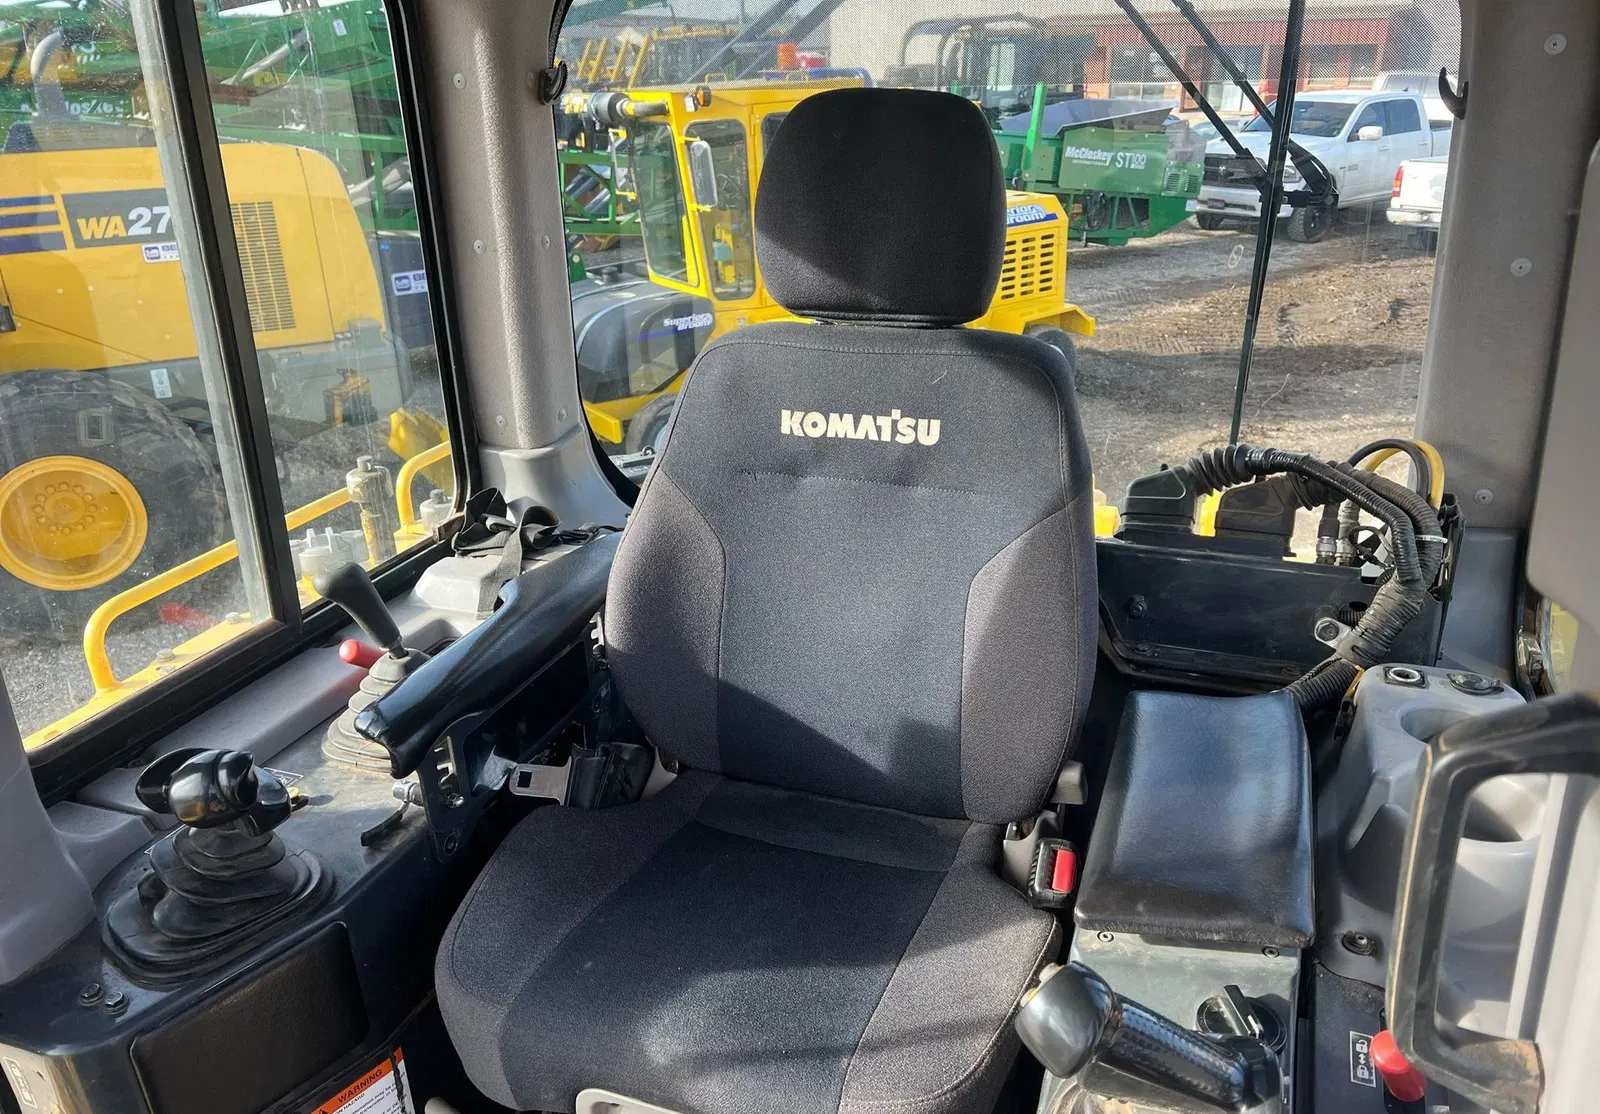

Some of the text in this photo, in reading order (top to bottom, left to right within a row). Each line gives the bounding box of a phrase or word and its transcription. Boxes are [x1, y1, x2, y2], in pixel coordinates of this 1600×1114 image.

[1065, 146, 1113, 166] McCloskey
[663, 314, 708, 327] Superior
[781, 408, 941, 446] KOMATSU
[337, 1069, 383, 1103] WARNING
